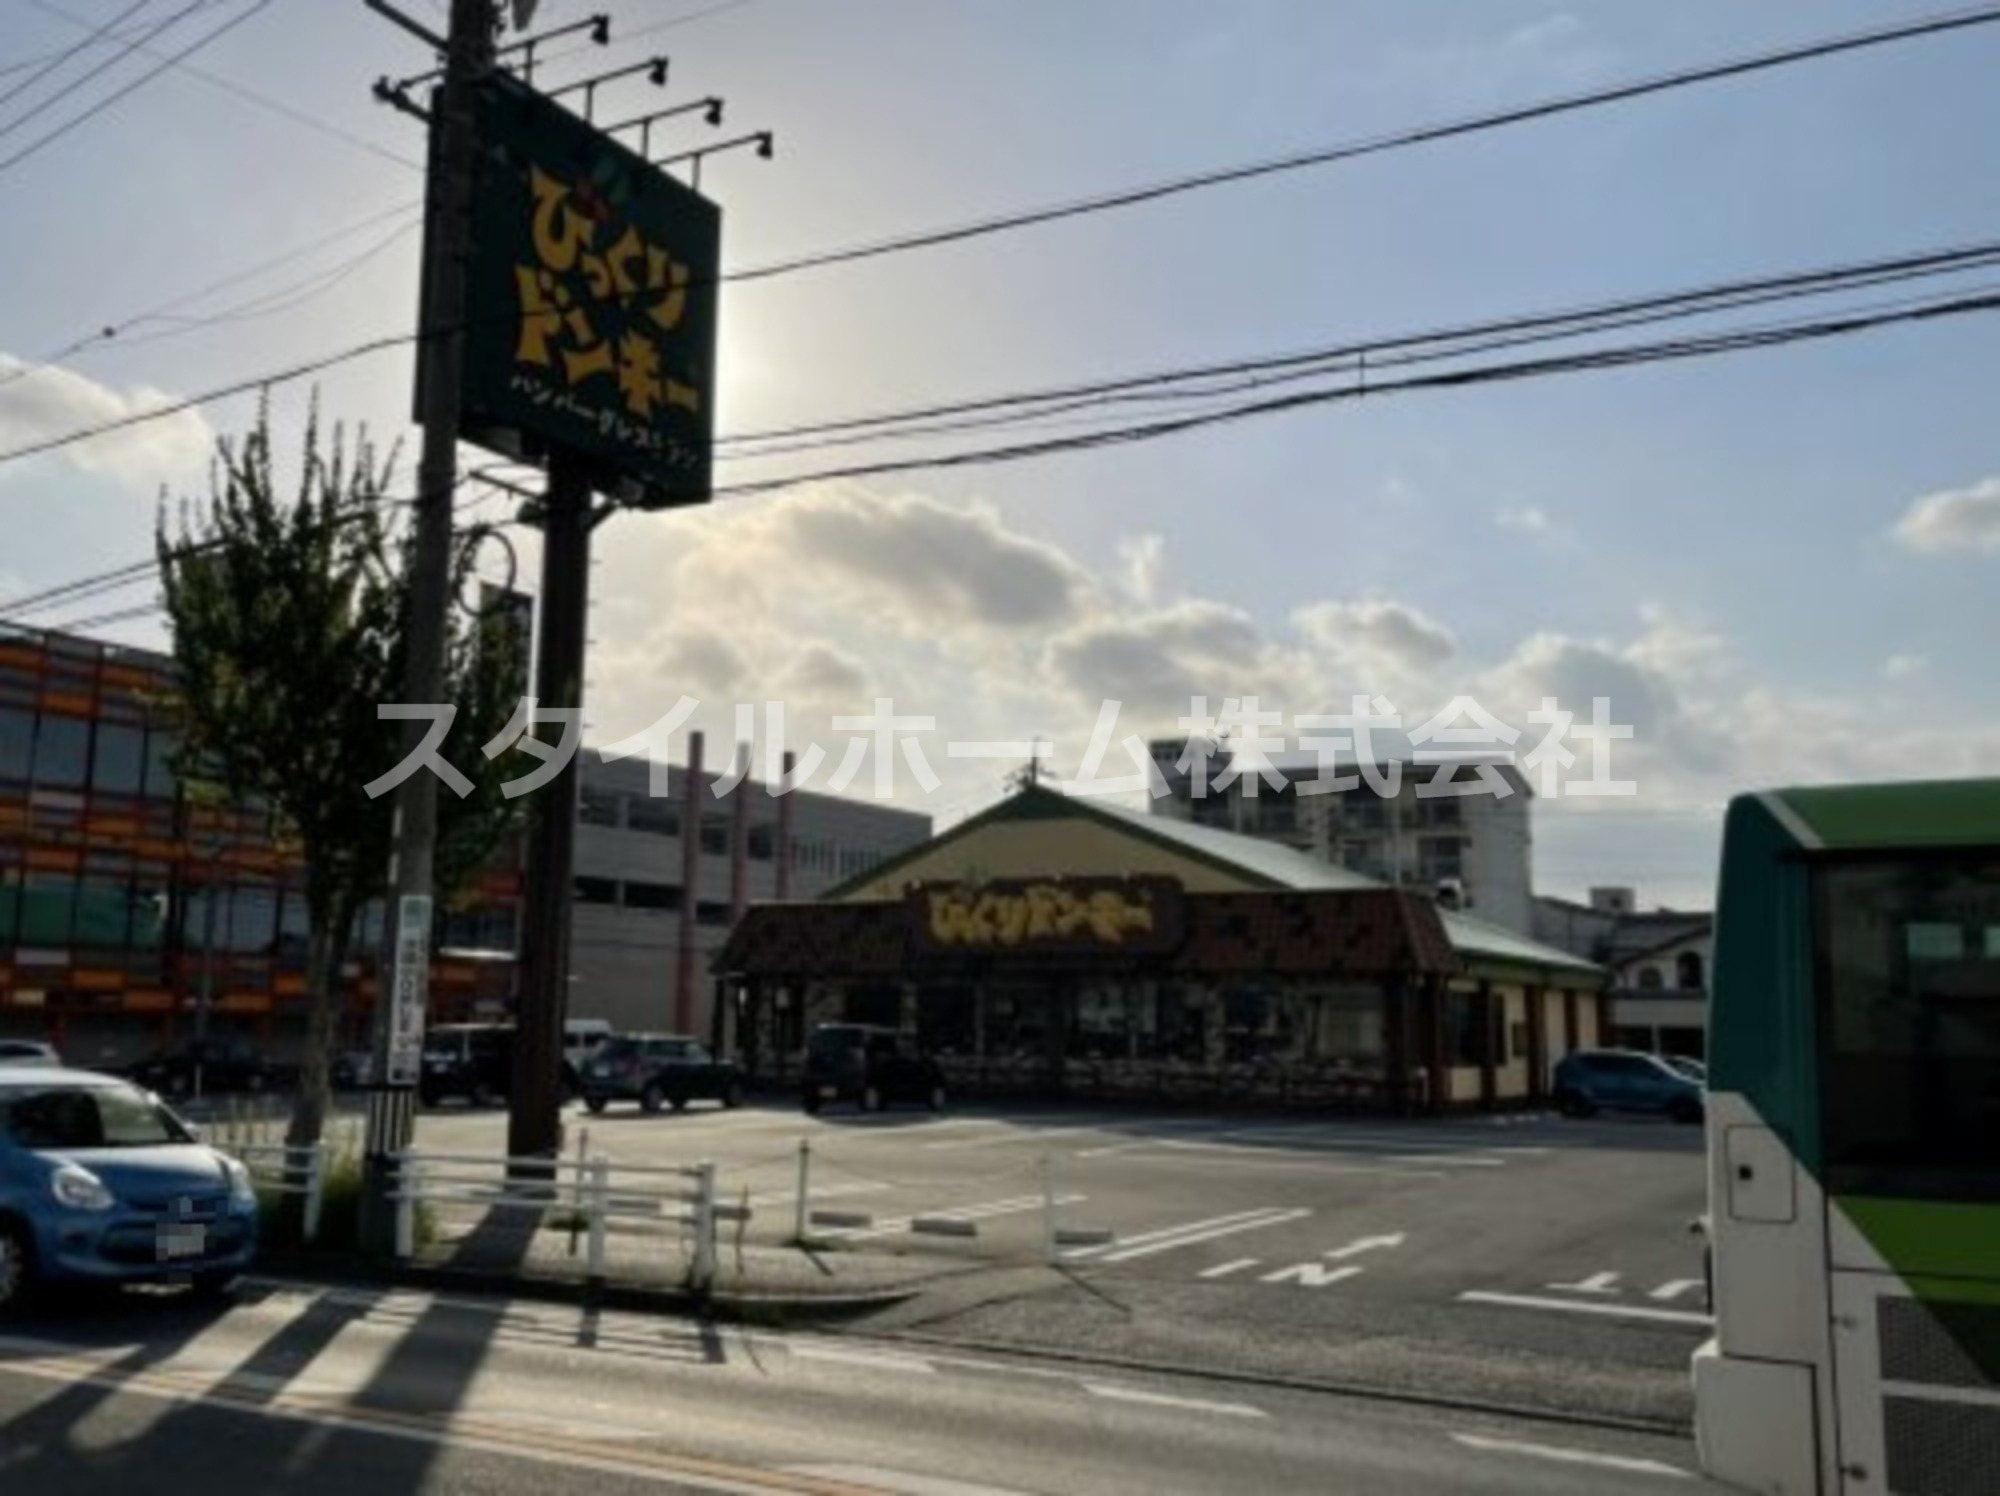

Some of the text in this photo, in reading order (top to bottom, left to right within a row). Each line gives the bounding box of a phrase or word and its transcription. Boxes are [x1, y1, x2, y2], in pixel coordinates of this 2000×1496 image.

[531, 166, 688, 329] びっくり
[515, 264, 698, 420] ドンキー
[928, 884, 1152, 945] びっくりドンキー
